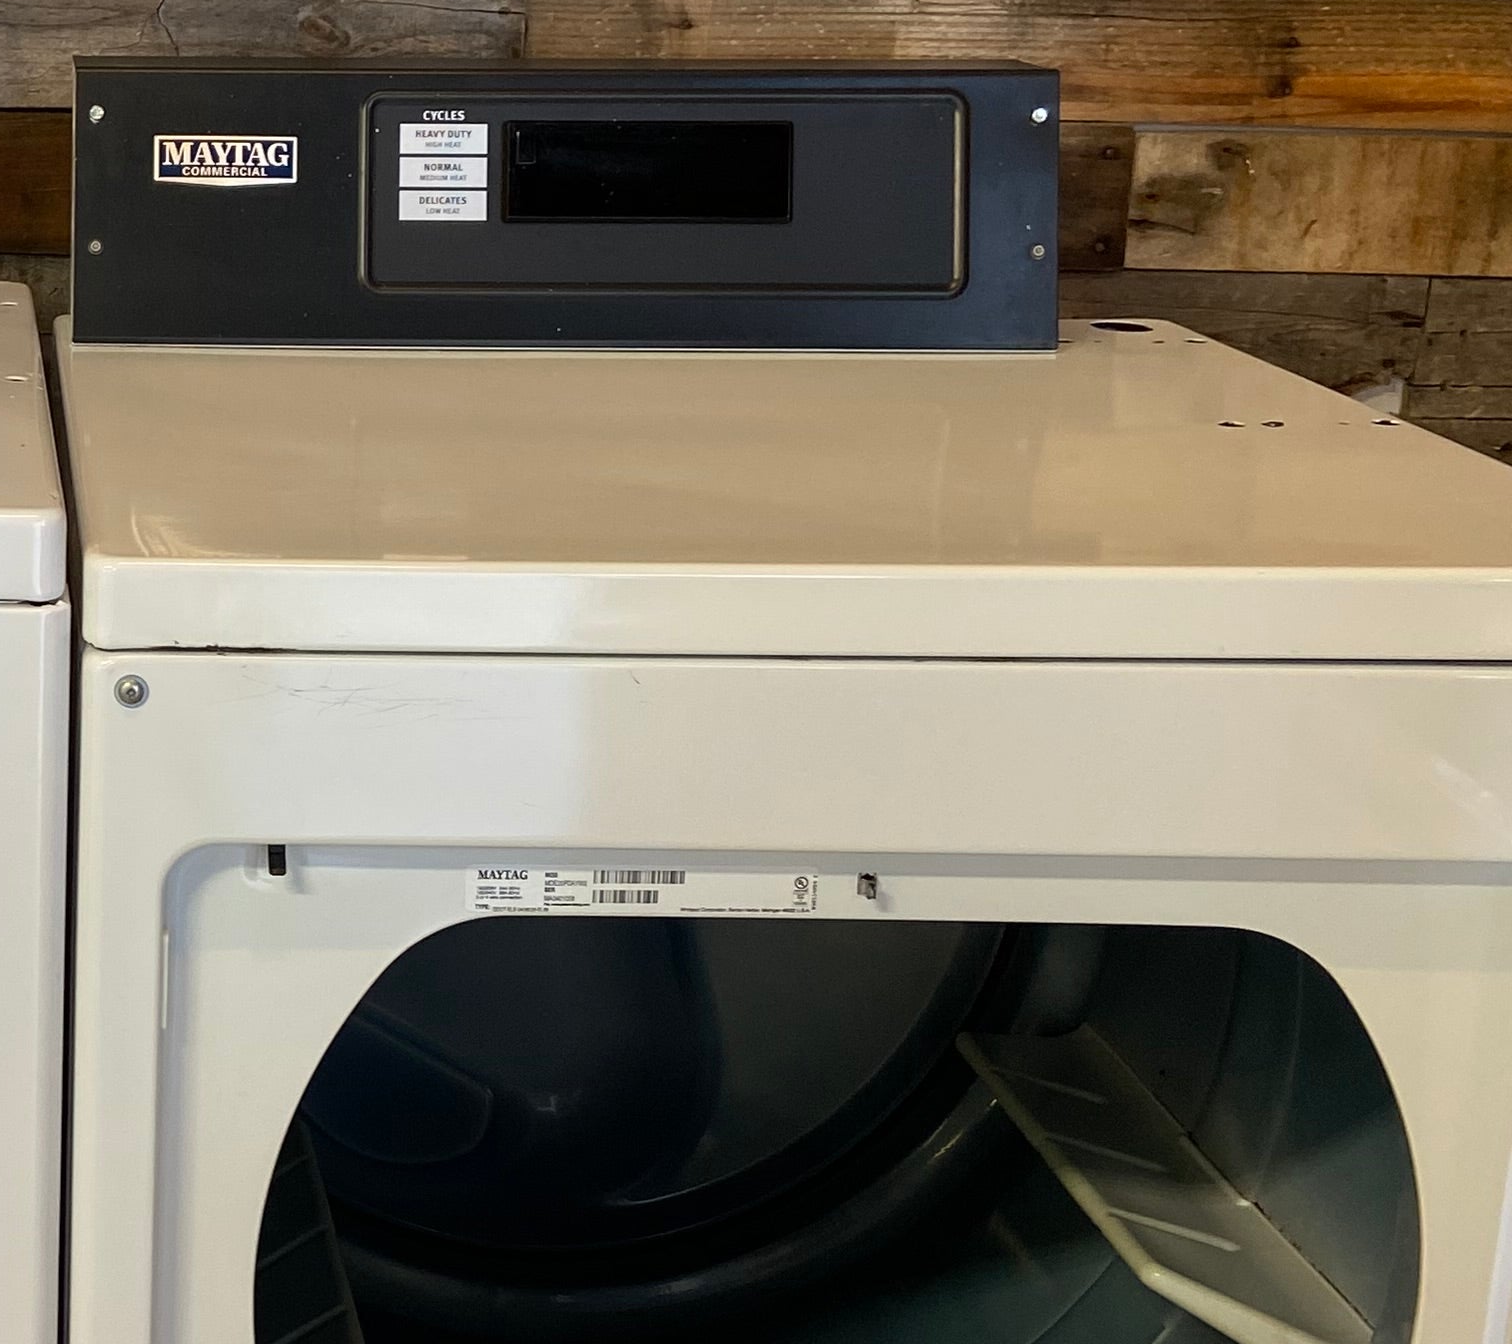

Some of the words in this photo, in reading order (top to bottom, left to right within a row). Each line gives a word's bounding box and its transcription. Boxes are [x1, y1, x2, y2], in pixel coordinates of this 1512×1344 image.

[422, 110, 465, 121] CYCLES
[415, 130, 445, 138] HEAVY
[447, 130, 472, 138] DUTY
[162, 141, 290, 167] MAYTAG
[182, 166, 268, 177] COMMERCIAL
[477, 869, 528, 880] MAYTAG
